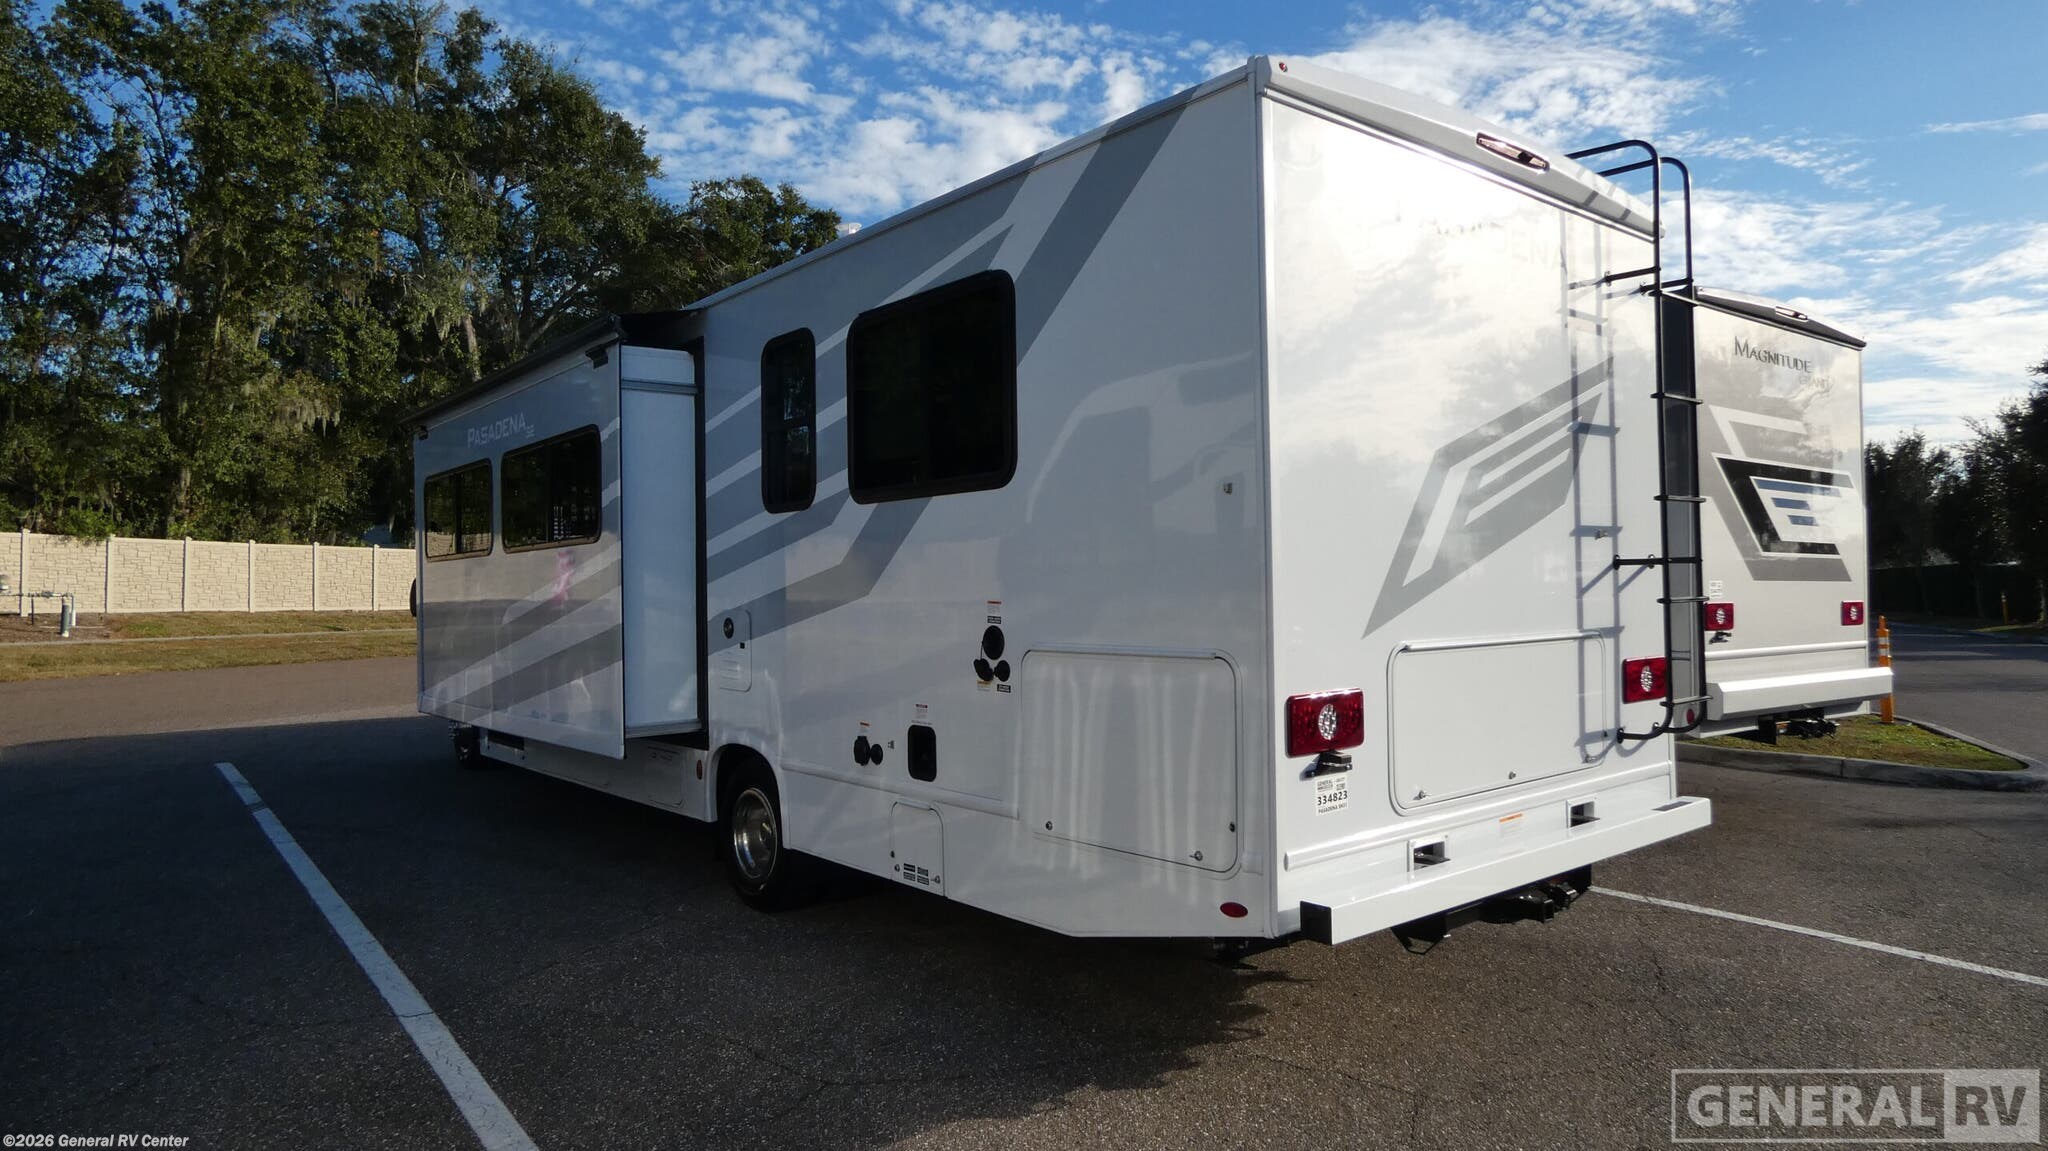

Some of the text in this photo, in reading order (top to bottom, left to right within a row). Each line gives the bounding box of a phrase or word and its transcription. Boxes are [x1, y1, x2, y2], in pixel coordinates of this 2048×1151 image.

[1734, 336, 1813, 374] MAGNITUDE
[467, 412, 527, 449] PASADENA
[1317, 790, 1348, 806] 334823
